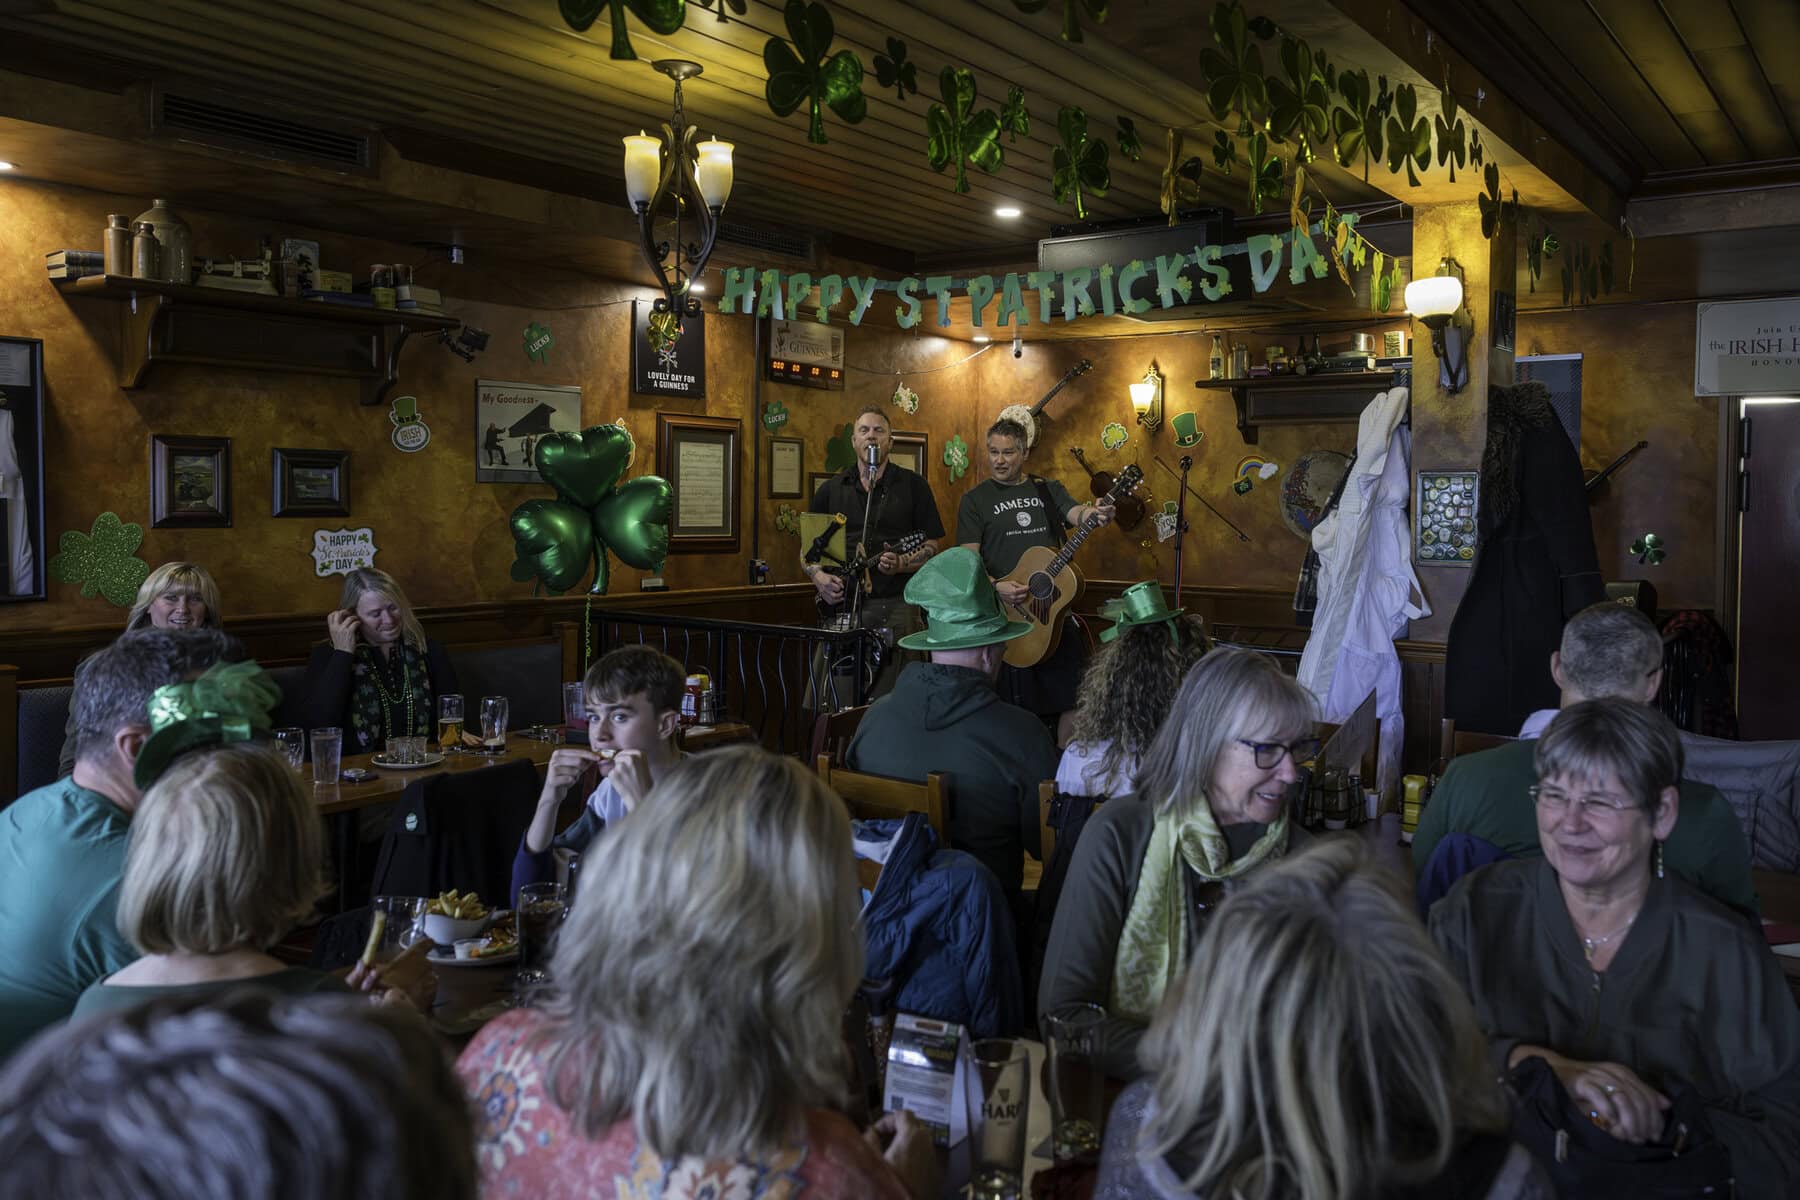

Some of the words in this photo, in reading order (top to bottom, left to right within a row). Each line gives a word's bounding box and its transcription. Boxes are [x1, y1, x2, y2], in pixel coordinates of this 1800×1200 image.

[718, 267, 877, 326] HAPPY
[896, 275, 952, 329] ST
[1709, 340, 1726, 351] the
[1729, 338, 1783, 355] IRISH
[647, 371, 670, 380] LOVELY
[671, 373, 682, 382] DAY
[683, 375, 696, 383] FOR
[653, 380, 658, 388] A
[659, 381, 689, 391] GUINNESS
[482, 393, 494, 404] My
[329, 535, 357, 546] HAPPY
[336, 559, 352, 570] DAY
